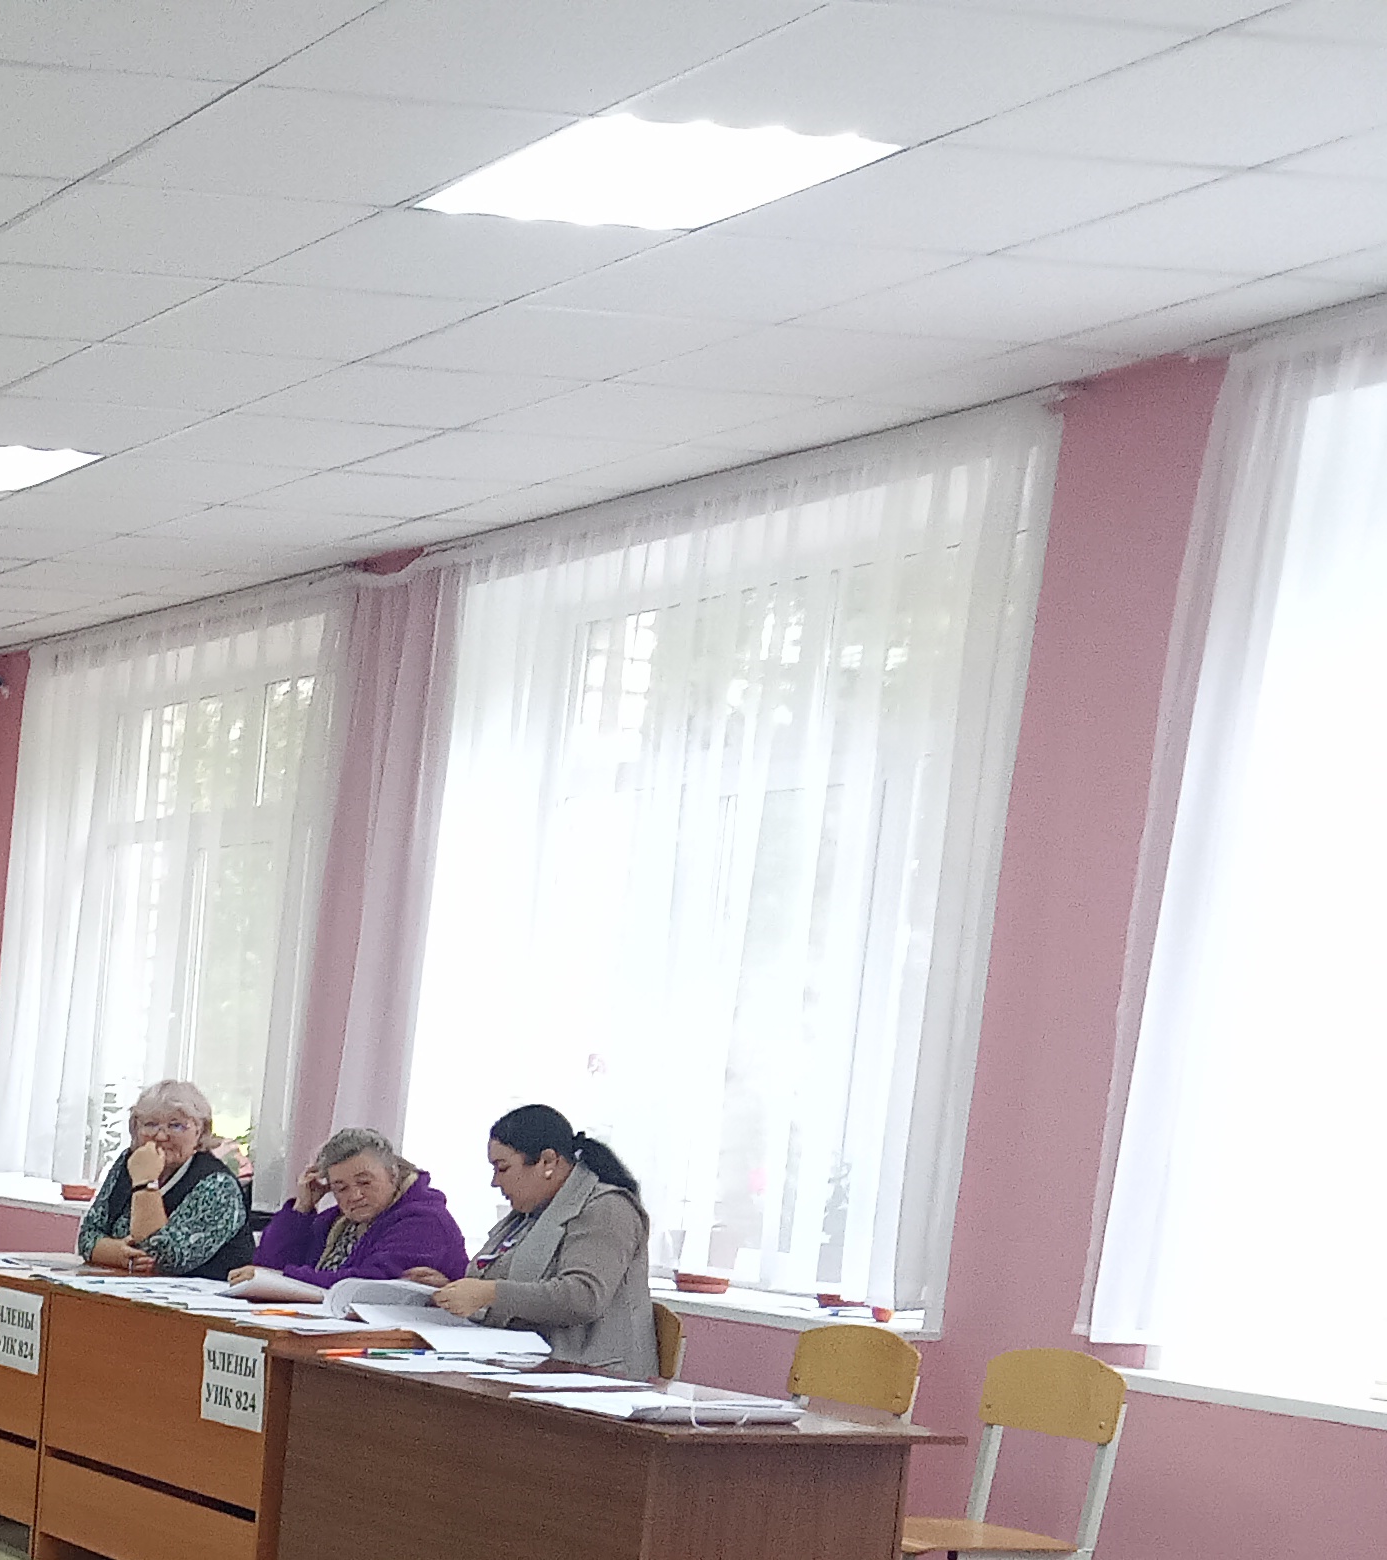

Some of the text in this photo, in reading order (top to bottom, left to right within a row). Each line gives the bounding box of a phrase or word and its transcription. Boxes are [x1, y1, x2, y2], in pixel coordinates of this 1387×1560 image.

[18, 1340, 34, 1360] 824
[207, 1349, 257, 1378] ЧЛЕНЫ
[206, 1383, 256, 1413] УИК 824
